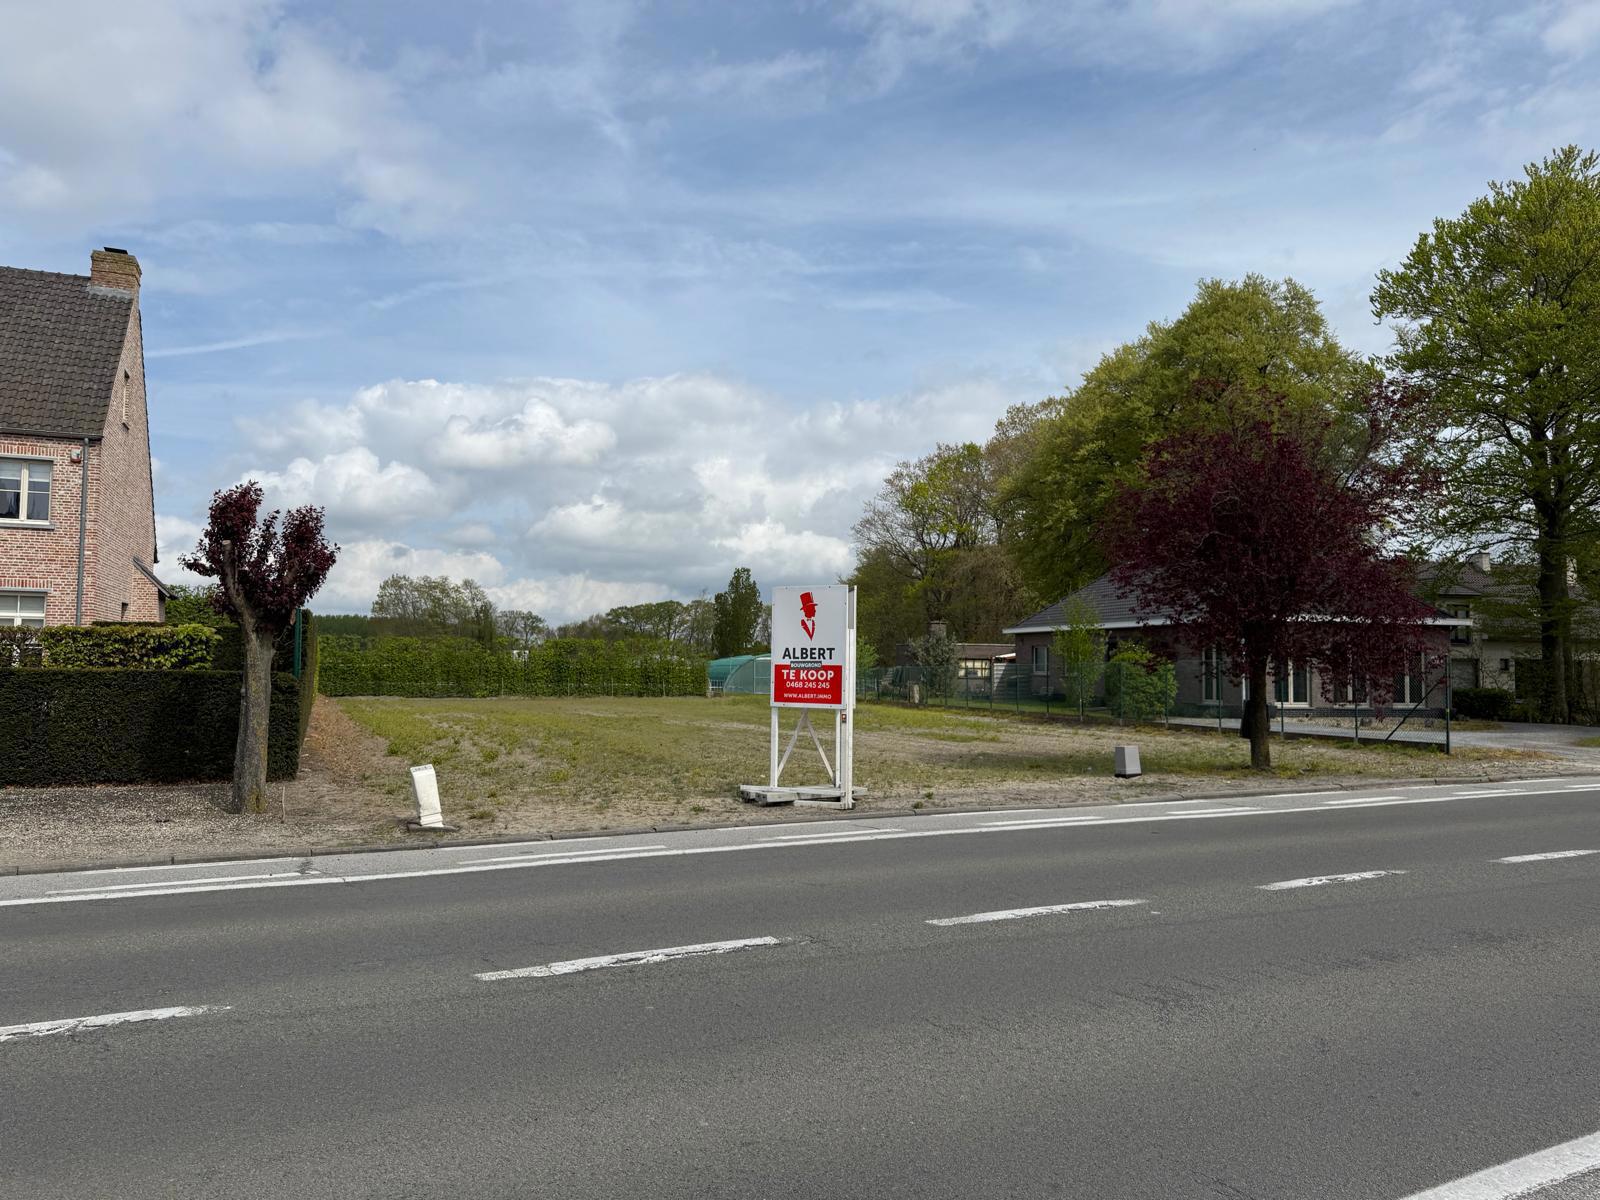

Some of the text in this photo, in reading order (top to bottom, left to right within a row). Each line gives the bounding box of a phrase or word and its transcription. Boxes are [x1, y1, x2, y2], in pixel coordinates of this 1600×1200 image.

[782, 648, 836, 660] ALBERT
[781, 669, 835, 681] TE KOOP
